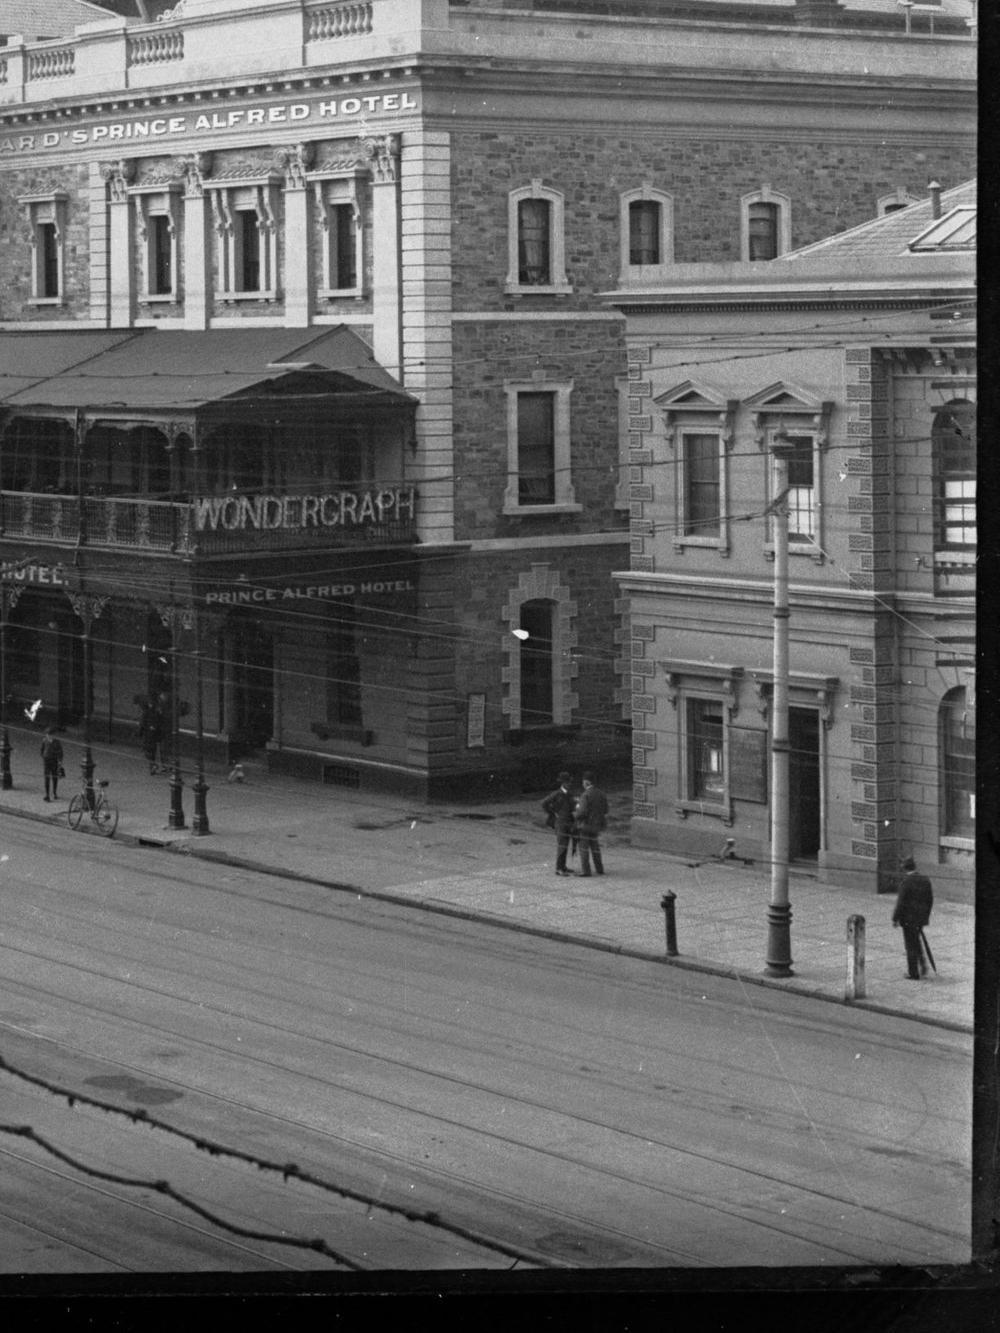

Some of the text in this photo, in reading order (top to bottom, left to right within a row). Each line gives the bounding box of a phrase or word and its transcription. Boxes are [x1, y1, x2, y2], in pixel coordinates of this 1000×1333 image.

[92, 116, 187, 142] PRINCE
[194, 103, 312, 130] ALFRED
[318, 92, 418, 118] HOTEL
[194, 487, 416, 531] WONDERGRAPH
[205, 579, 416, 605] PRINCE ALFRED HOTEL
